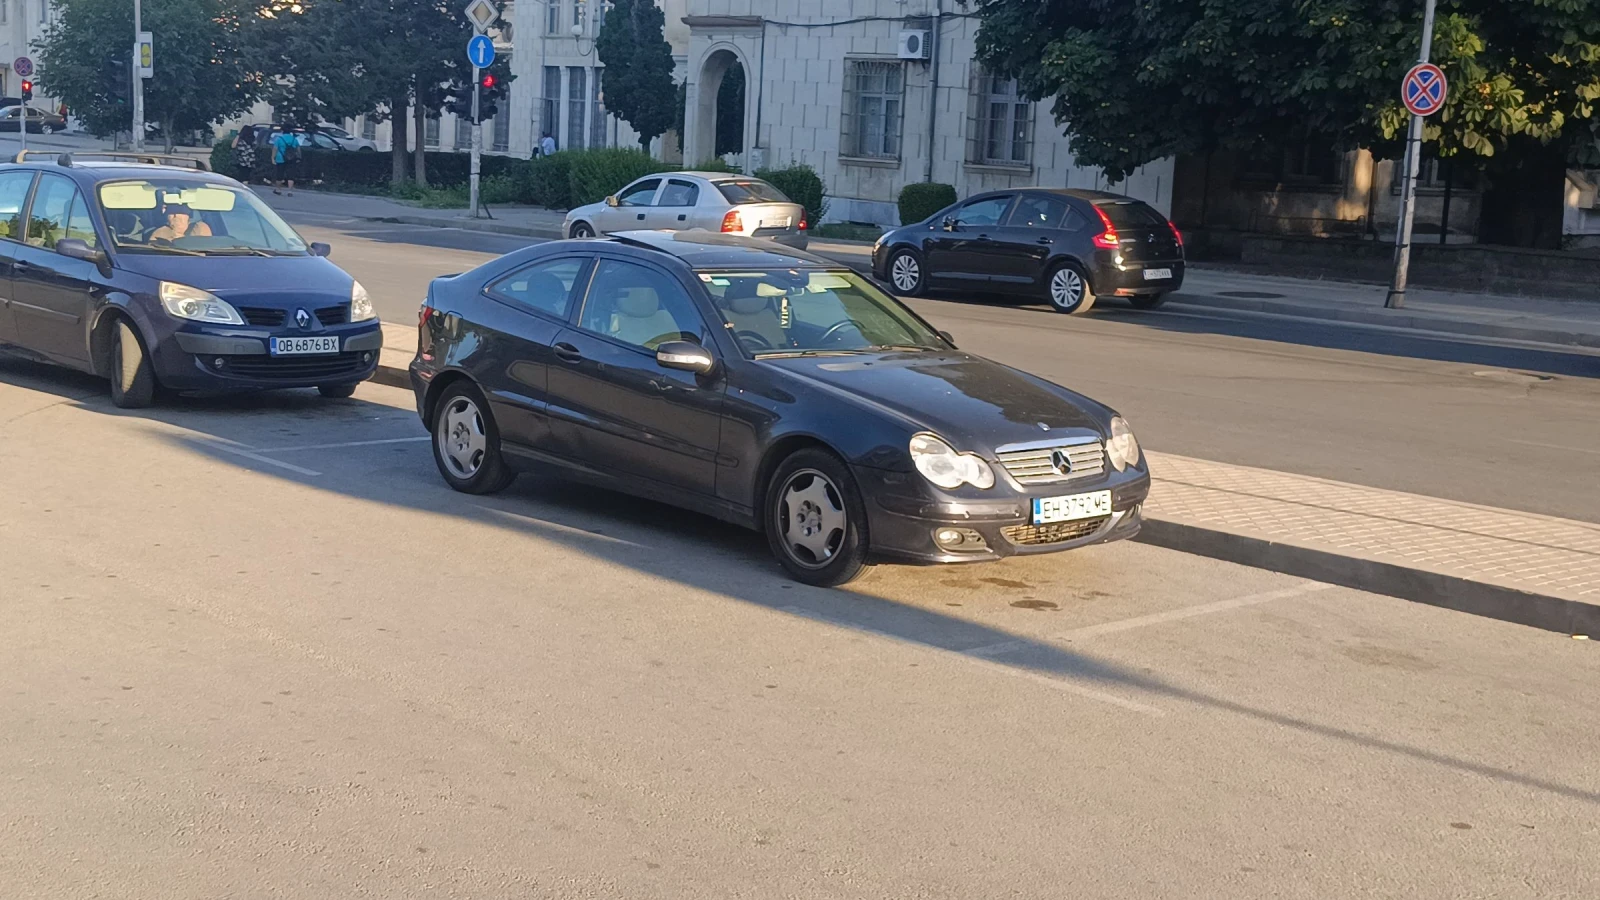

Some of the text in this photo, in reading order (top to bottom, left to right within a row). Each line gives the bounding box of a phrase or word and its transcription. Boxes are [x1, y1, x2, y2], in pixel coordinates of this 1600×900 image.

[295, 338, 322, 351] 6876
[323, 338, 337, 351] BX
[1043, 501, 1060, 519] EH
